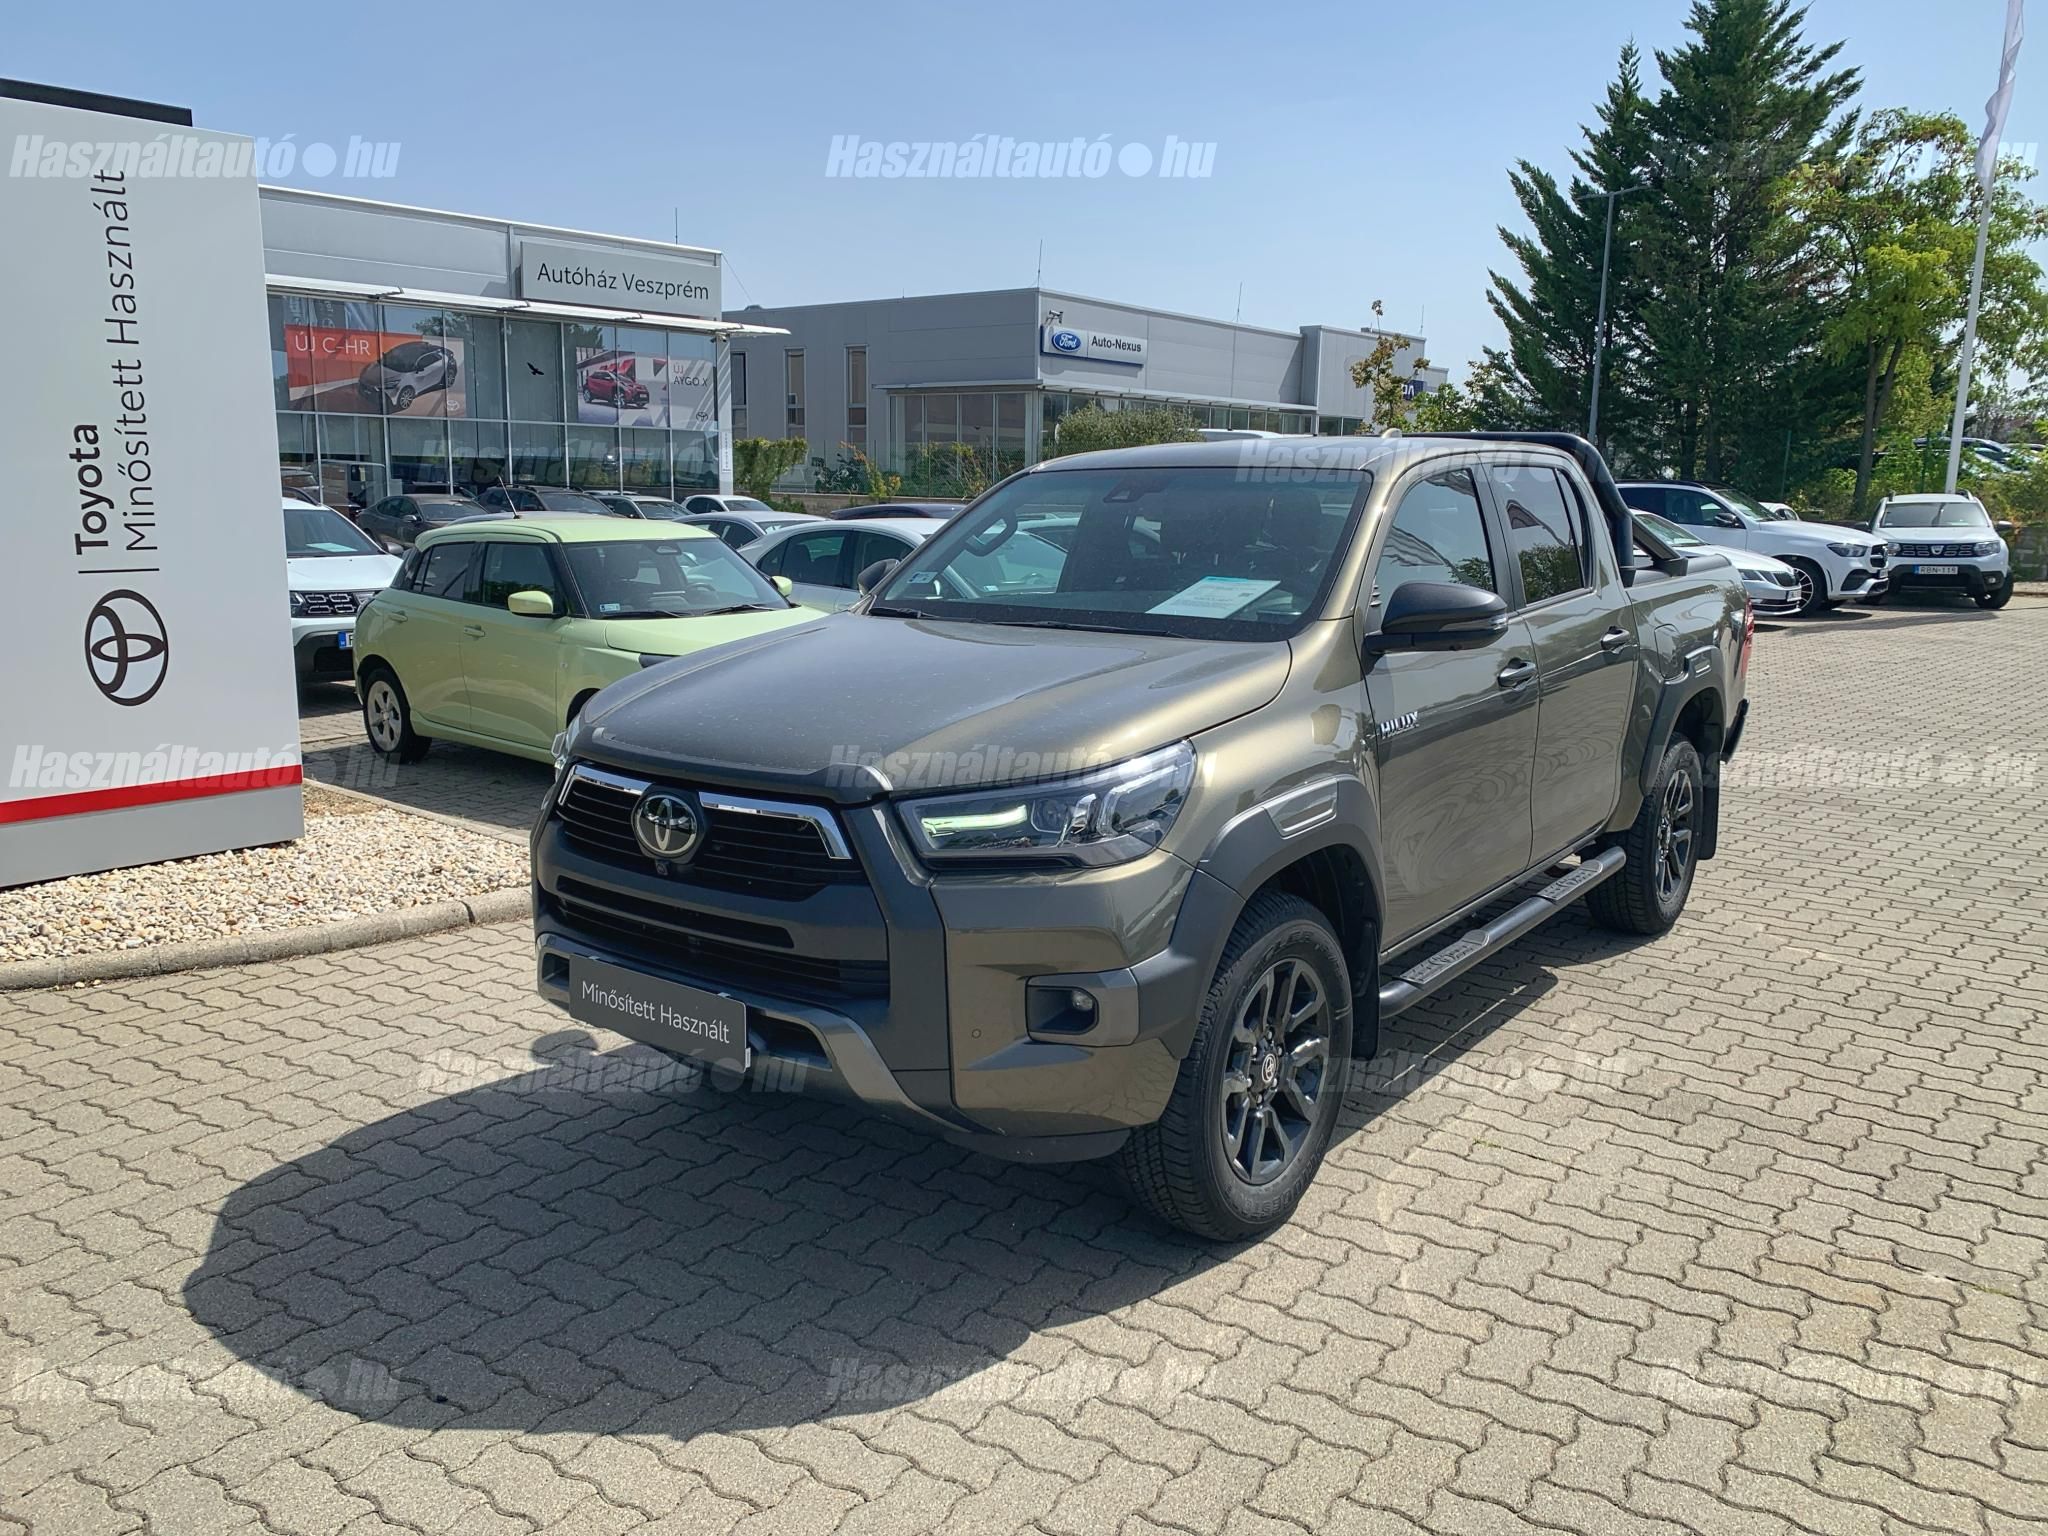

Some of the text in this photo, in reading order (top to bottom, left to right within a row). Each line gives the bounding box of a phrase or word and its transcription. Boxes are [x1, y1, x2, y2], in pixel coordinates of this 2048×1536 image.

[537, 262, 709, 300] Autóház Veszprém
[295, 331, 371, 356] ÚJ C-HR
[1059, 333, 1078, 349] Ford
[1091, 335, 1142, 353] Auto-Nexus
[90, 168, 158, 552] Minősített Használt
[673, 376, 699, 387] AYGO
[69, 423, 114, 556] Toyota
[1380, 711, 1418, 734] HILUX
[582, 980, 730, 1044] Minősített Használt
